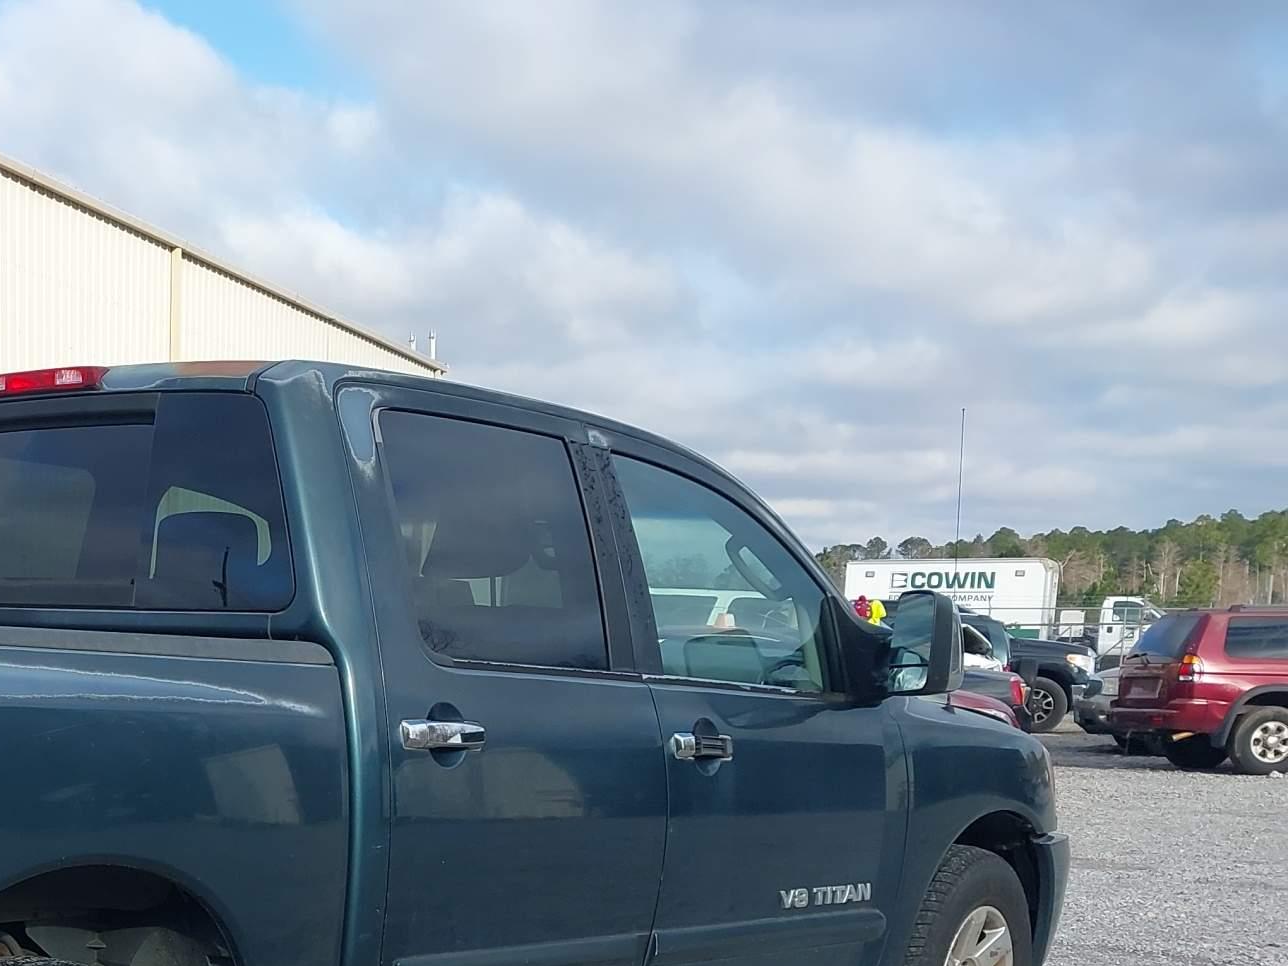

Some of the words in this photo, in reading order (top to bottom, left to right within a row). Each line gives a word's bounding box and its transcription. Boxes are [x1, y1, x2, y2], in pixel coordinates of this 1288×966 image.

[910, 571, 996, 589] COWIN
[779, 887, 809, 909] V8
[813, 882, 872, 906] TITAN
